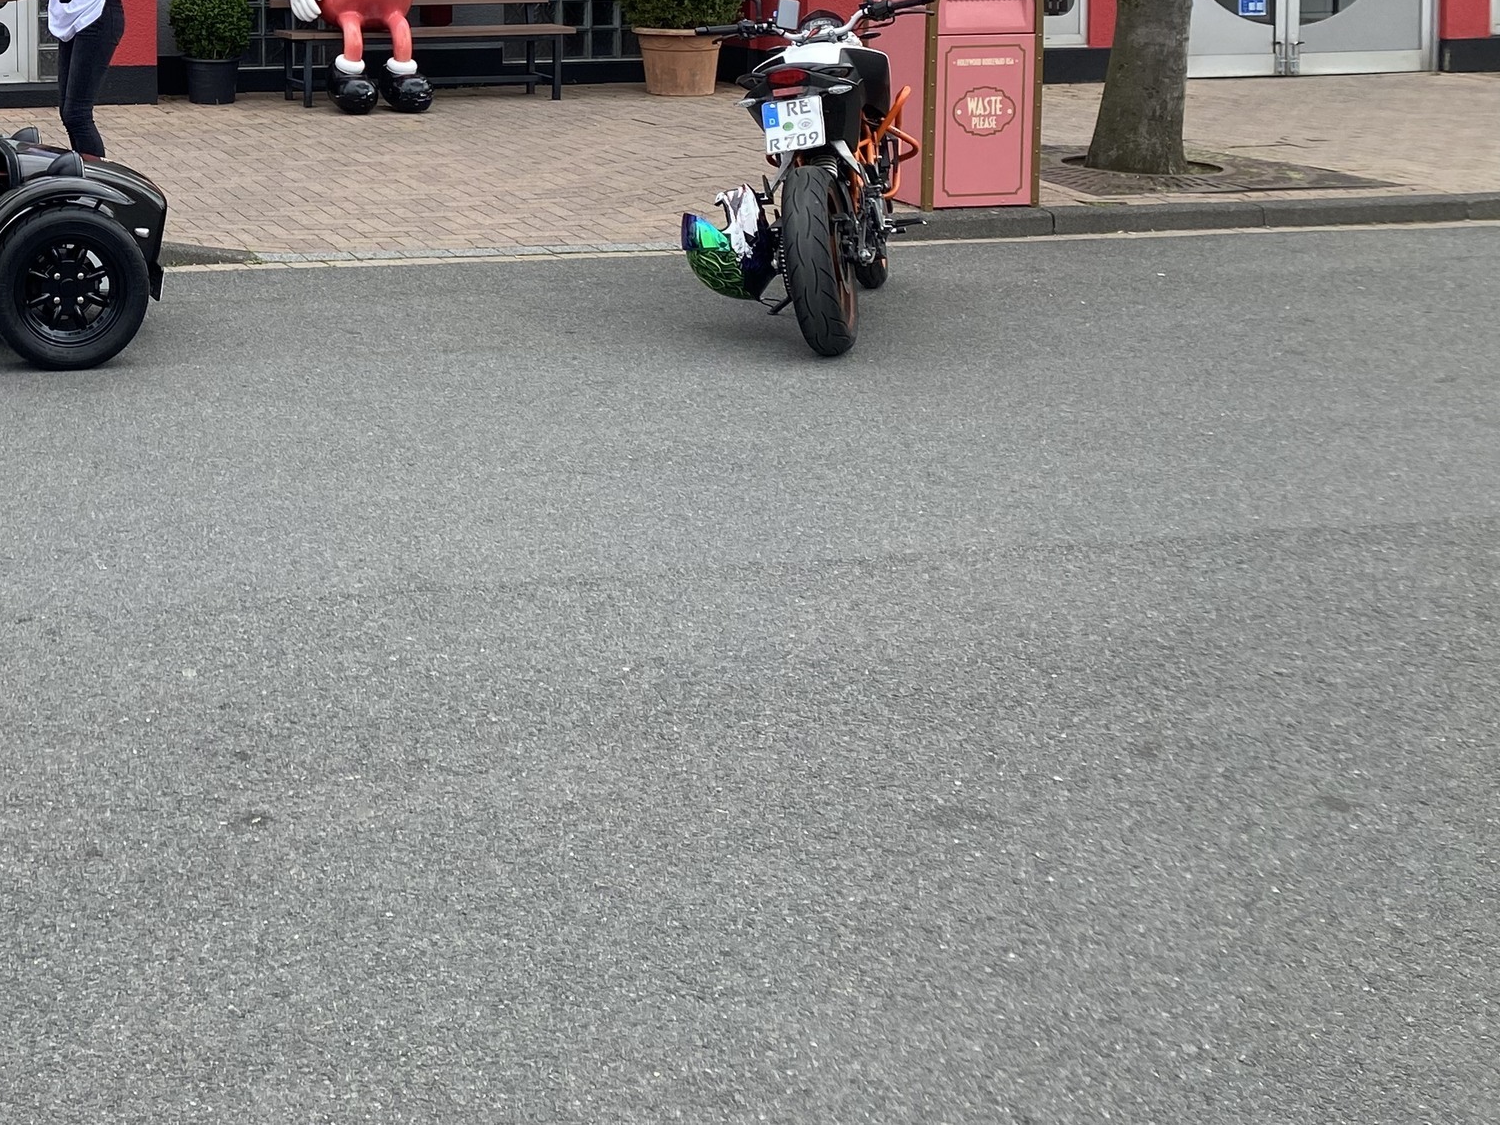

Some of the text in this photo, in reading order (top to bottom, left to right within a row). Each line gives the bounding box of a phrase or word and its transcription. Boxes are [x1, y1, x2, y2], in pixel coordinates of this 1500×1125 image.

[786, 99, 811, 116] RE
[967, 96, 1003, 115] WASTE
[971, 116, 997, 129] PLEASE
[769, 131, 819, 151] R 709
